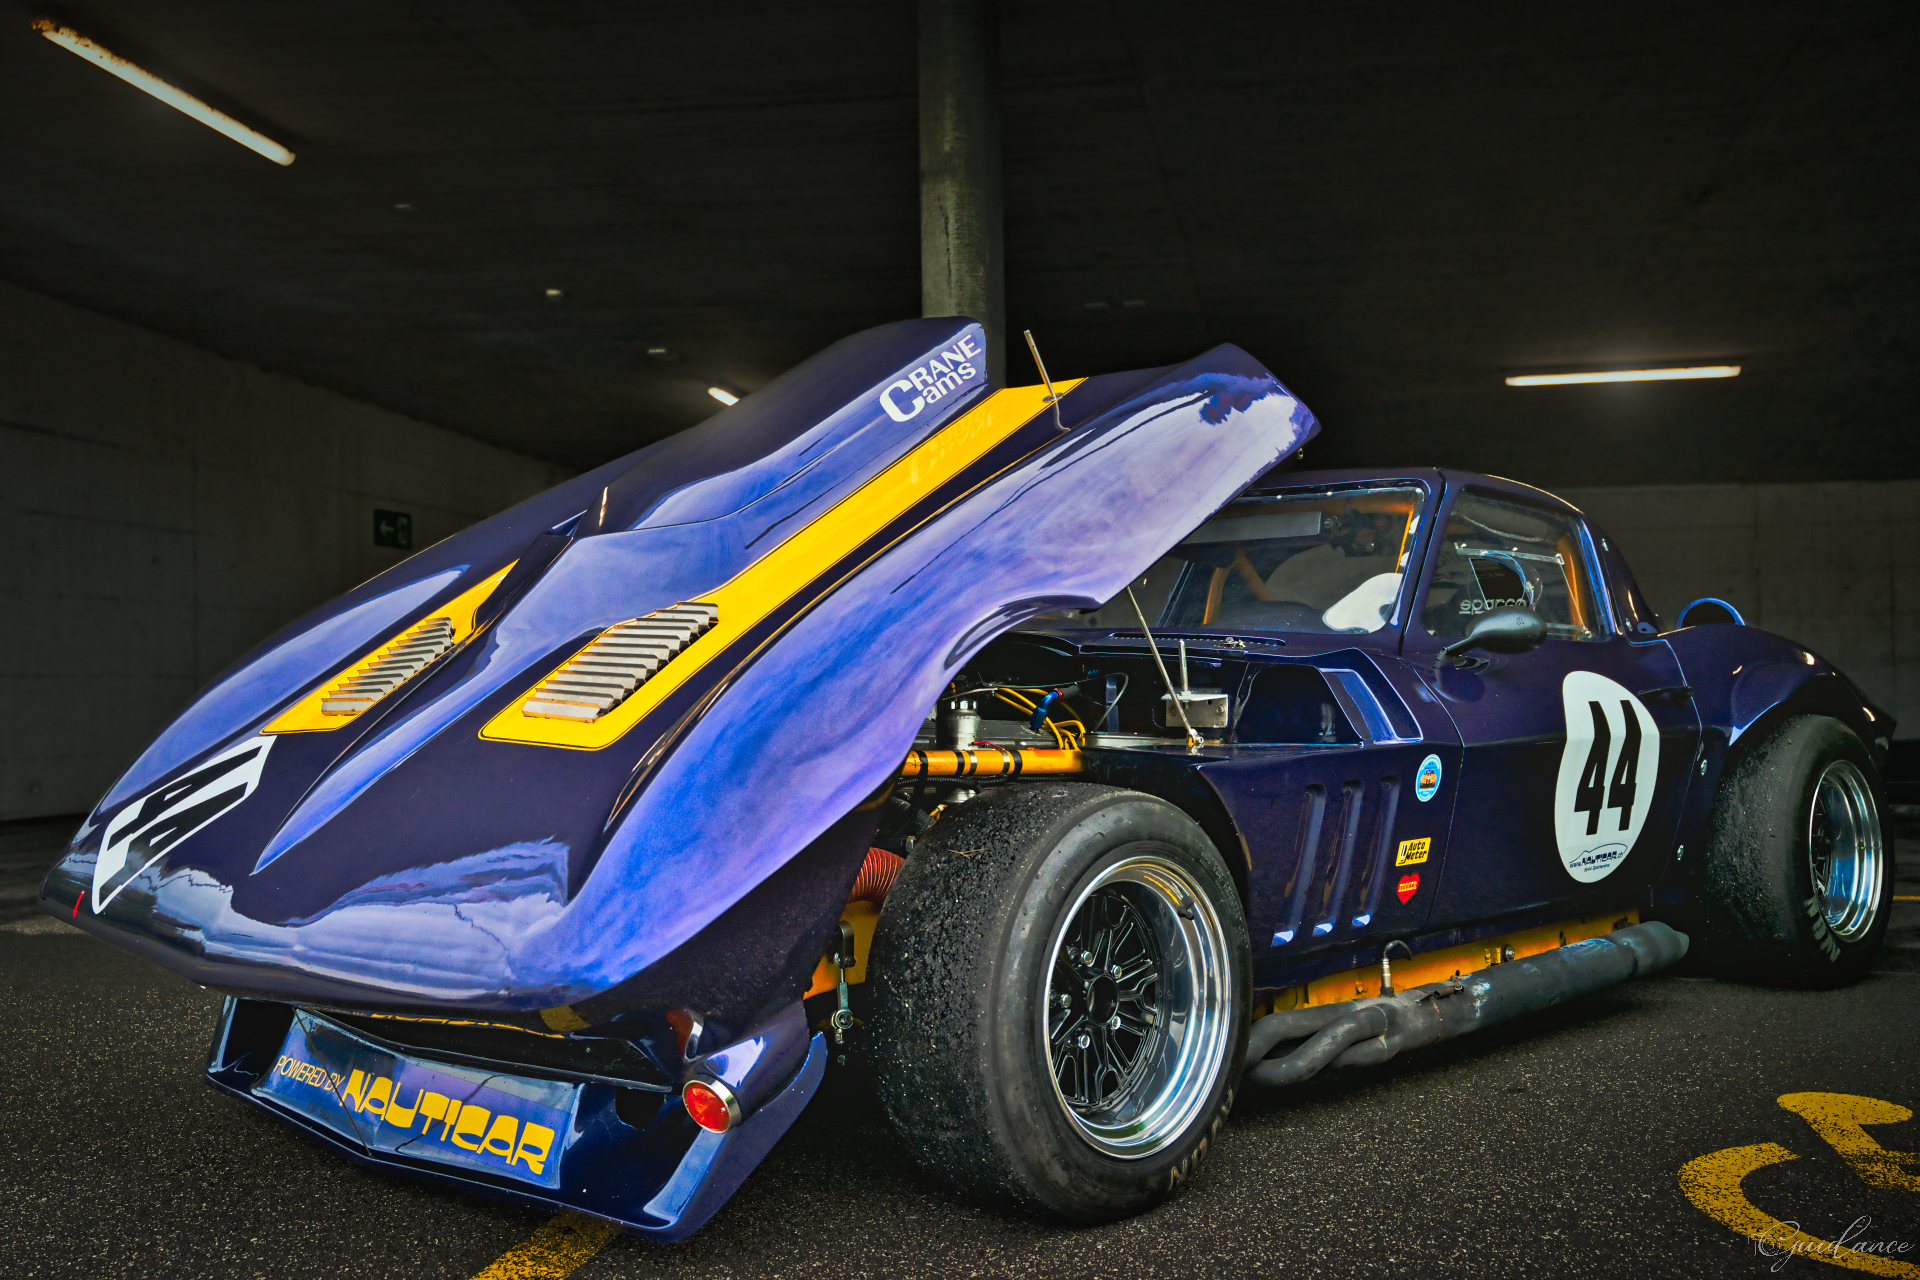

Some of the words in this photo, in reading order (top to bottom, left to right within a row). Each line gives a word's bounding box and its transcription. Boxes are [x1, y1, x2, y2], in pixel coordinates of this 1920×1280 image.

[880, 334, 982, 422] CRANE
[1460, 598, 1527, 615] sparco
[1574, 699, 1642, 835] 44
[99, 745, 263, 908] 44
[1405, 850, 1428, 861] Meter
[1408, 841, 1426, 851] Auto
[273, 1054, 328, 1087] POWERED
[323, 1072, 346, 1093] BY
[338, 1068, 555, 1175] NAUTICAR
